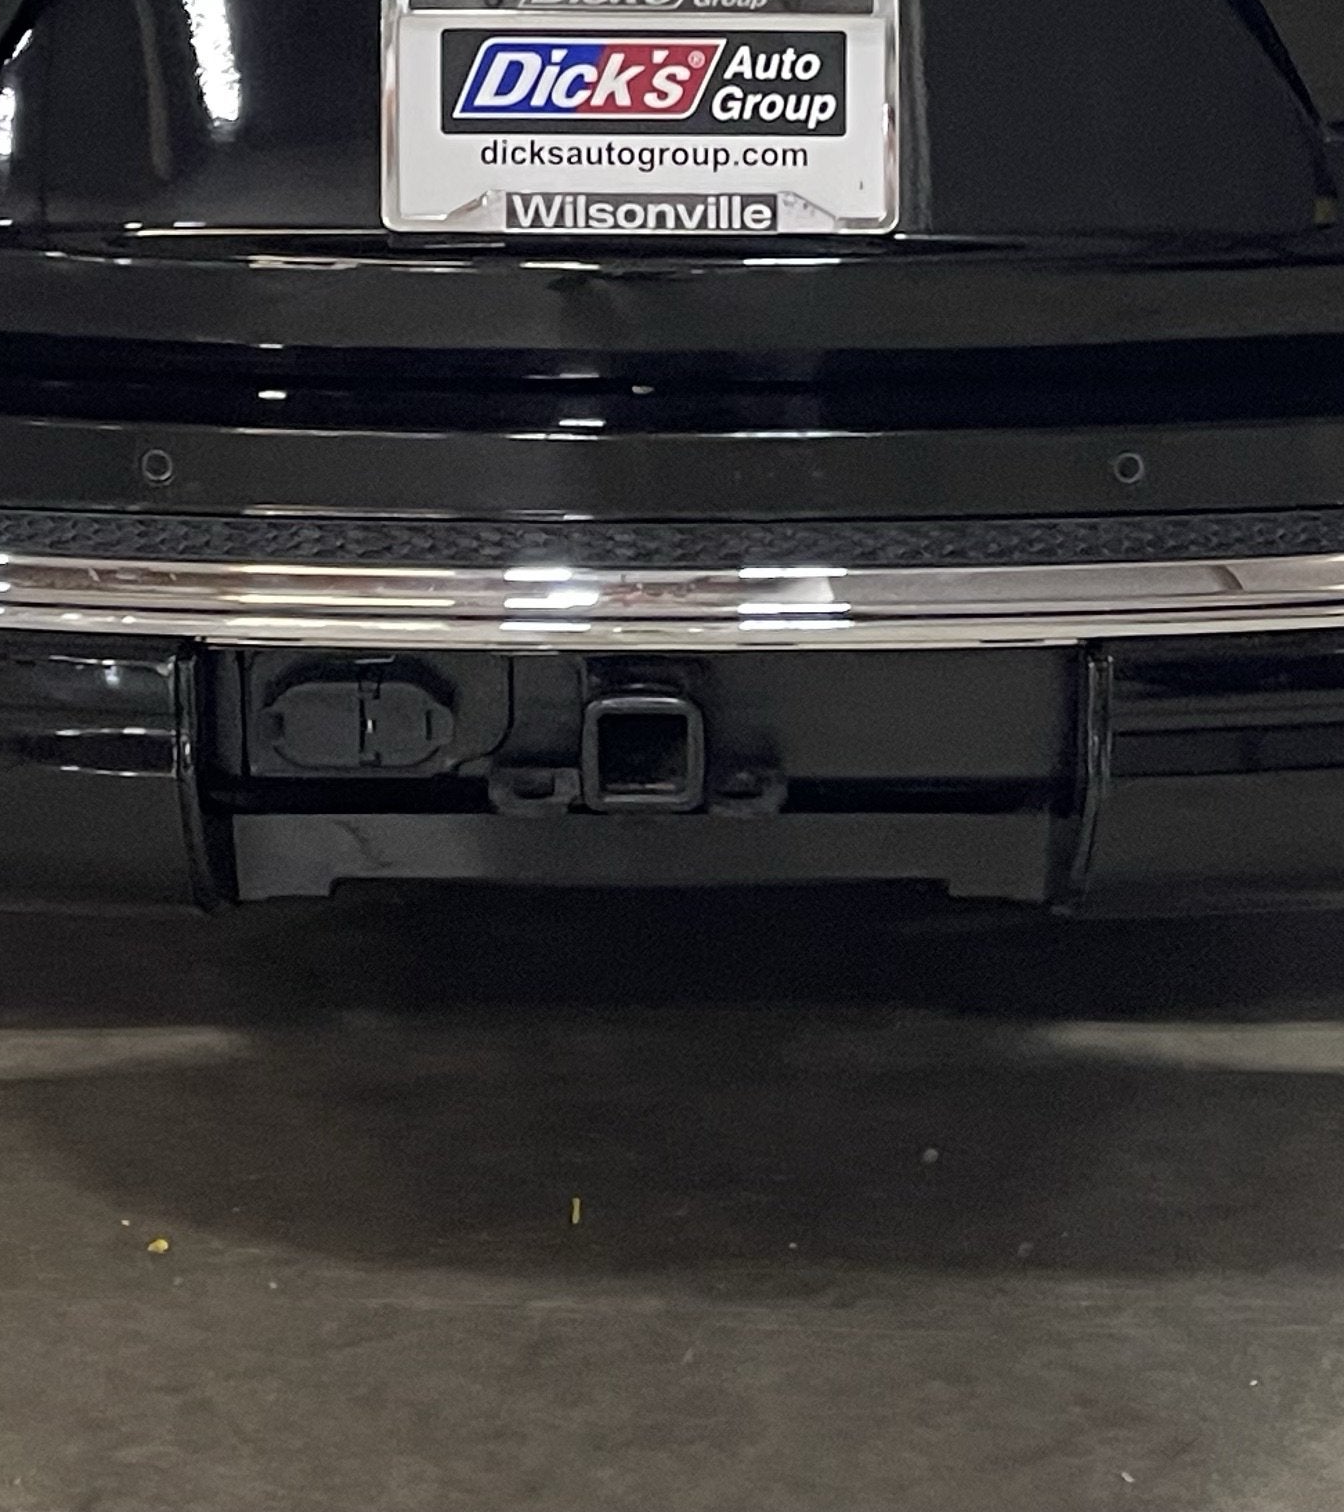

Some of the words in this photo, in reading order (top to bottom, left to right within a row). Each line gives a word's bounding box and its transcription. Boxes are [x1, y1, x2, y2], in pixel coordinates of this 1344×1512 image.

[723, 45, 821, 81] Auto
[711, 86, 837, 129] Group
[480, 138, 809, 172] dicksautogroup.com
[512, 193, 774, 231] Wilsonville
